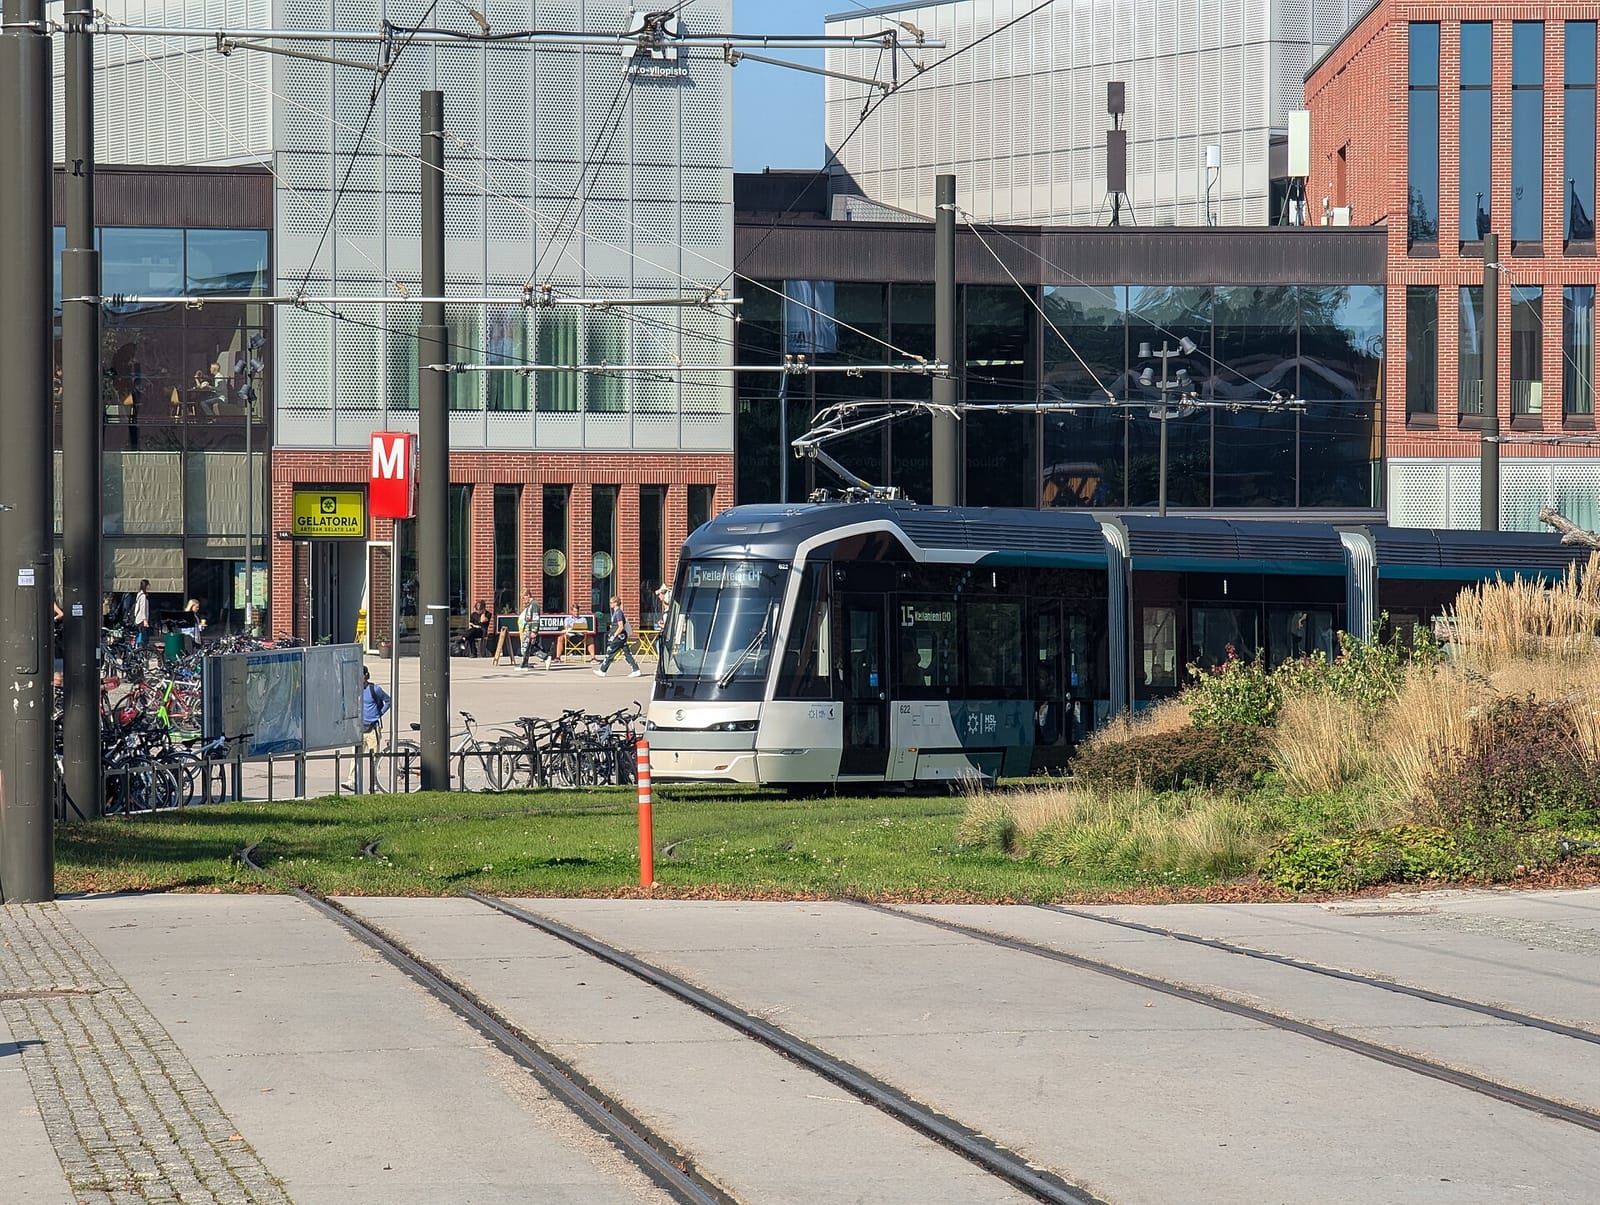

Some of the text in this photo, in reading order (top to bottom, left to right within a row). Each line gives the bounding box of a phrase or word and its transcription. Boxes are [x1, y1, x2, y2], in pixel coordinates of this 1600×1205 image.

[372, 437, 405, 479] M
[297, 516, 358, 526] GELATORIA
[901, 606, 914, 627] 15
[539, 617, 564, 627] ETORIA
[900, 705, 911, 714] 622
[984, 714, 997, 723] HSL
[984, 724, 997, 732] HRT
